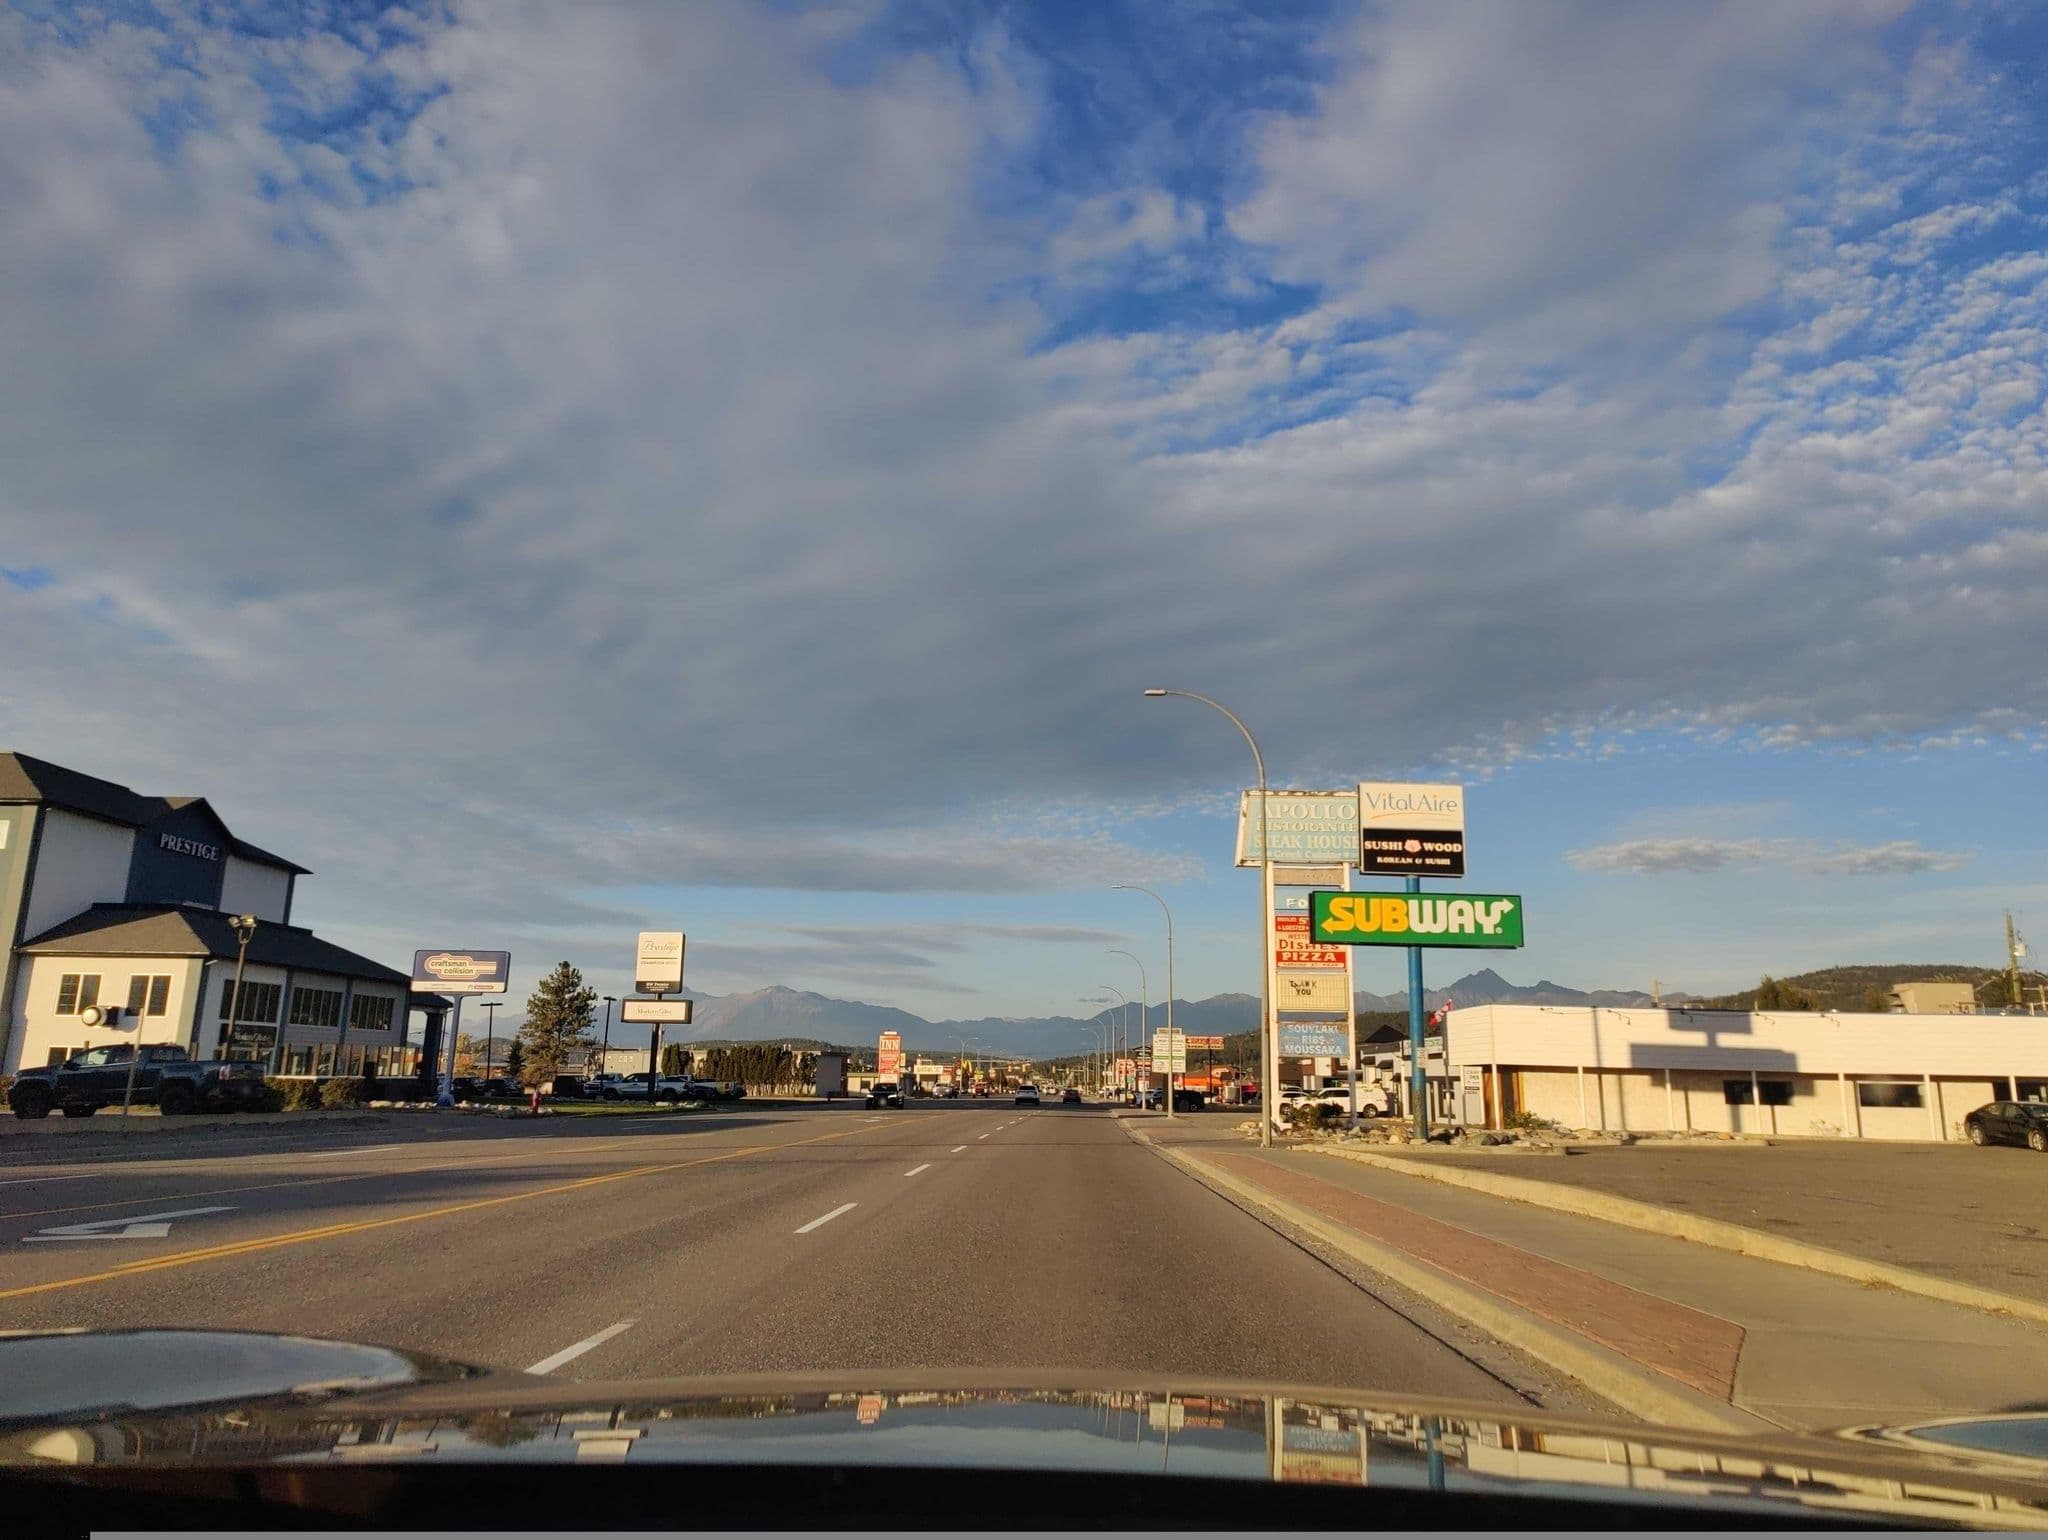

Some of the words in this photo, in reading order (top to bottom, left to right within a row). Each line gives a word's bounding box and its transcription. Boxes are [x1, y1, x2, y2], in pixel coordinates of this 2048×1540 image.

[1366, 792, 1458, 812] VitalAire
[1257, 803, 1357, 820] APOLLO
[160, 833, 219, 861] PRESTIGE
[1255, 835, 1302, 849] SEAK
[1364, 841, 1403, 851] SUSHI
[1423, 842, 1462, 853] WOOD
[1377, 856, 1413, 864] KOREAN
[1321, 896, 1514, 935] SUBWAY
[1279, 939, 1339, 950] DISHES
[430, 957, 468, 967] craftsman
[1281, 951, 1337, 962] PIZZA
[443, 967, 474, 975] collision
[881, 1040, 899, 1050] INN
[1301, 1035, 1325, 1045] RIBS
[1284, 1044, 1342, 1055] MOUSSAKA
